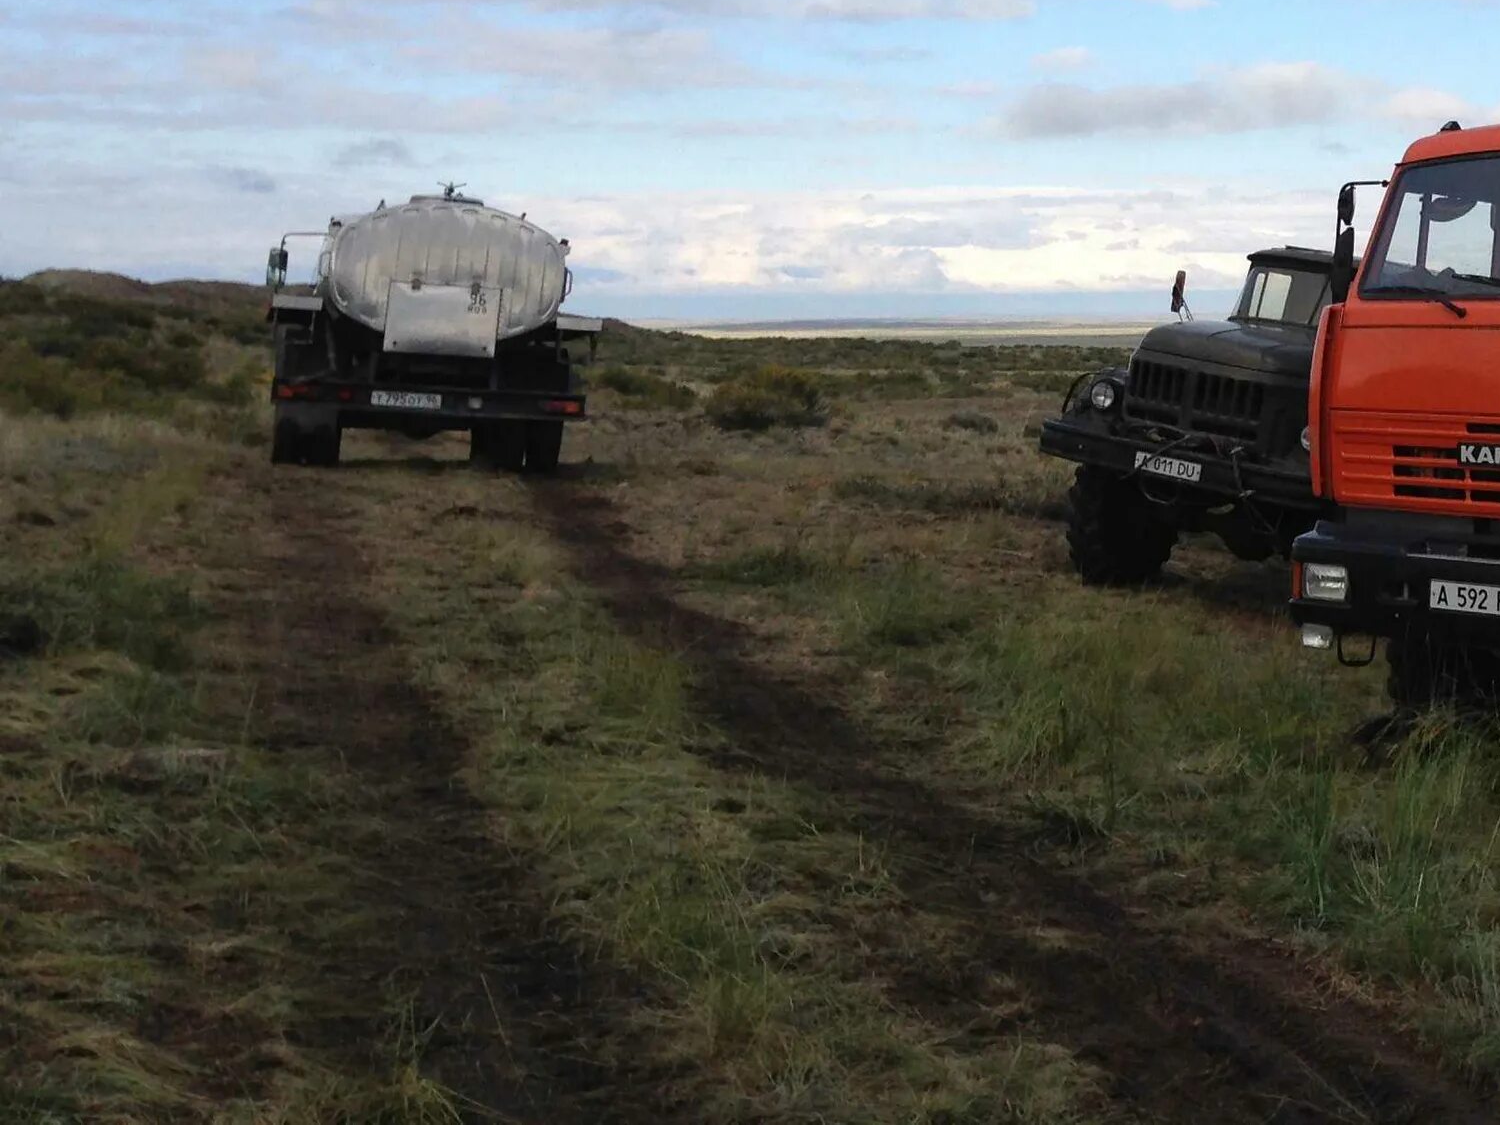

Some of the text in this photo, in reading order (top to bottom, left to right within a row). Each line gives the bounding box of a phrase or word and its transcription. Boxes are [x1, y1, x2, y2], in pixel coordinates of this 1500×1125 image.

[1154, 458, 1173, 474] 011
[1177, 462, 1195, 478] DU
[1437, 584, 1449, 606] A
[1457, 586, 1488, 610] 592
